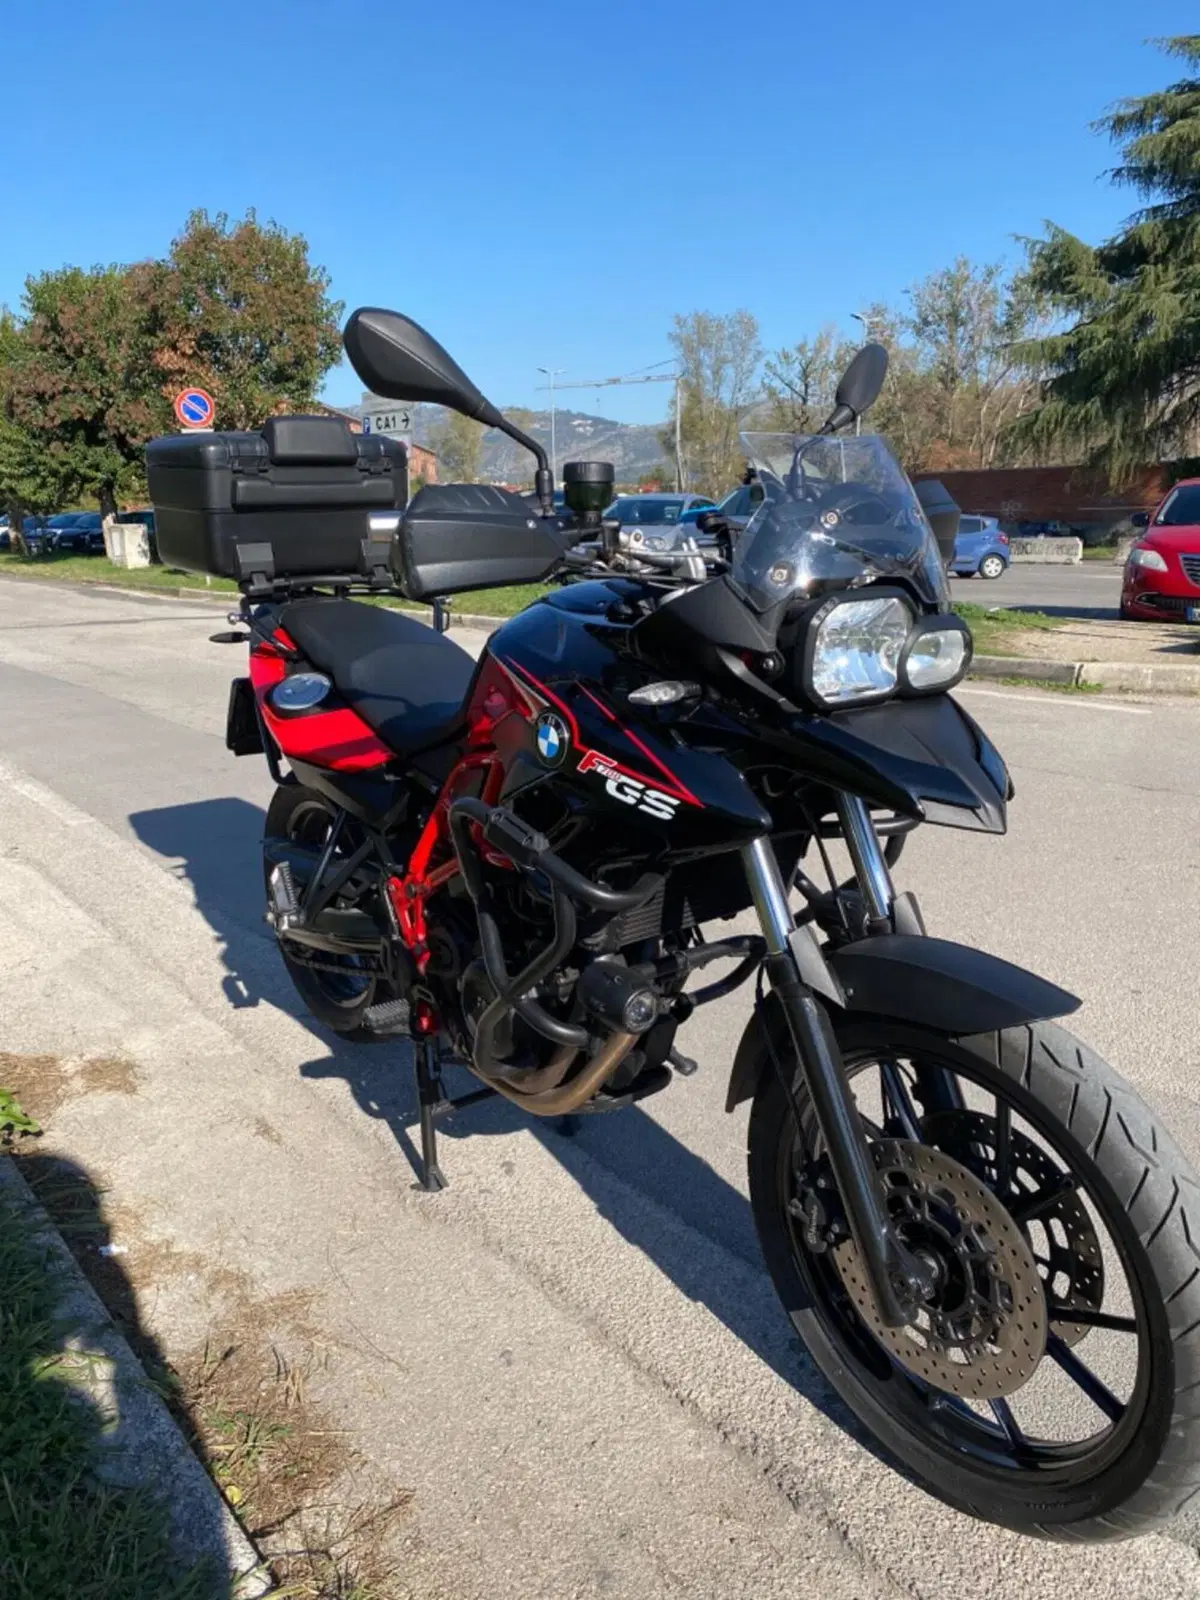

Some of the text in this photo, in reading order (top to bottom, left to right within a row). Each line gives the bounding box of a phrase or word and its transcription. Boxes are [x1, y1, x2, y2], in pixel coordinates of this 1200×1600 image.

[376, 415, 396, 430] CA1
[577, 749, 618, 774] F
[606, 773, 681, 820] GS
